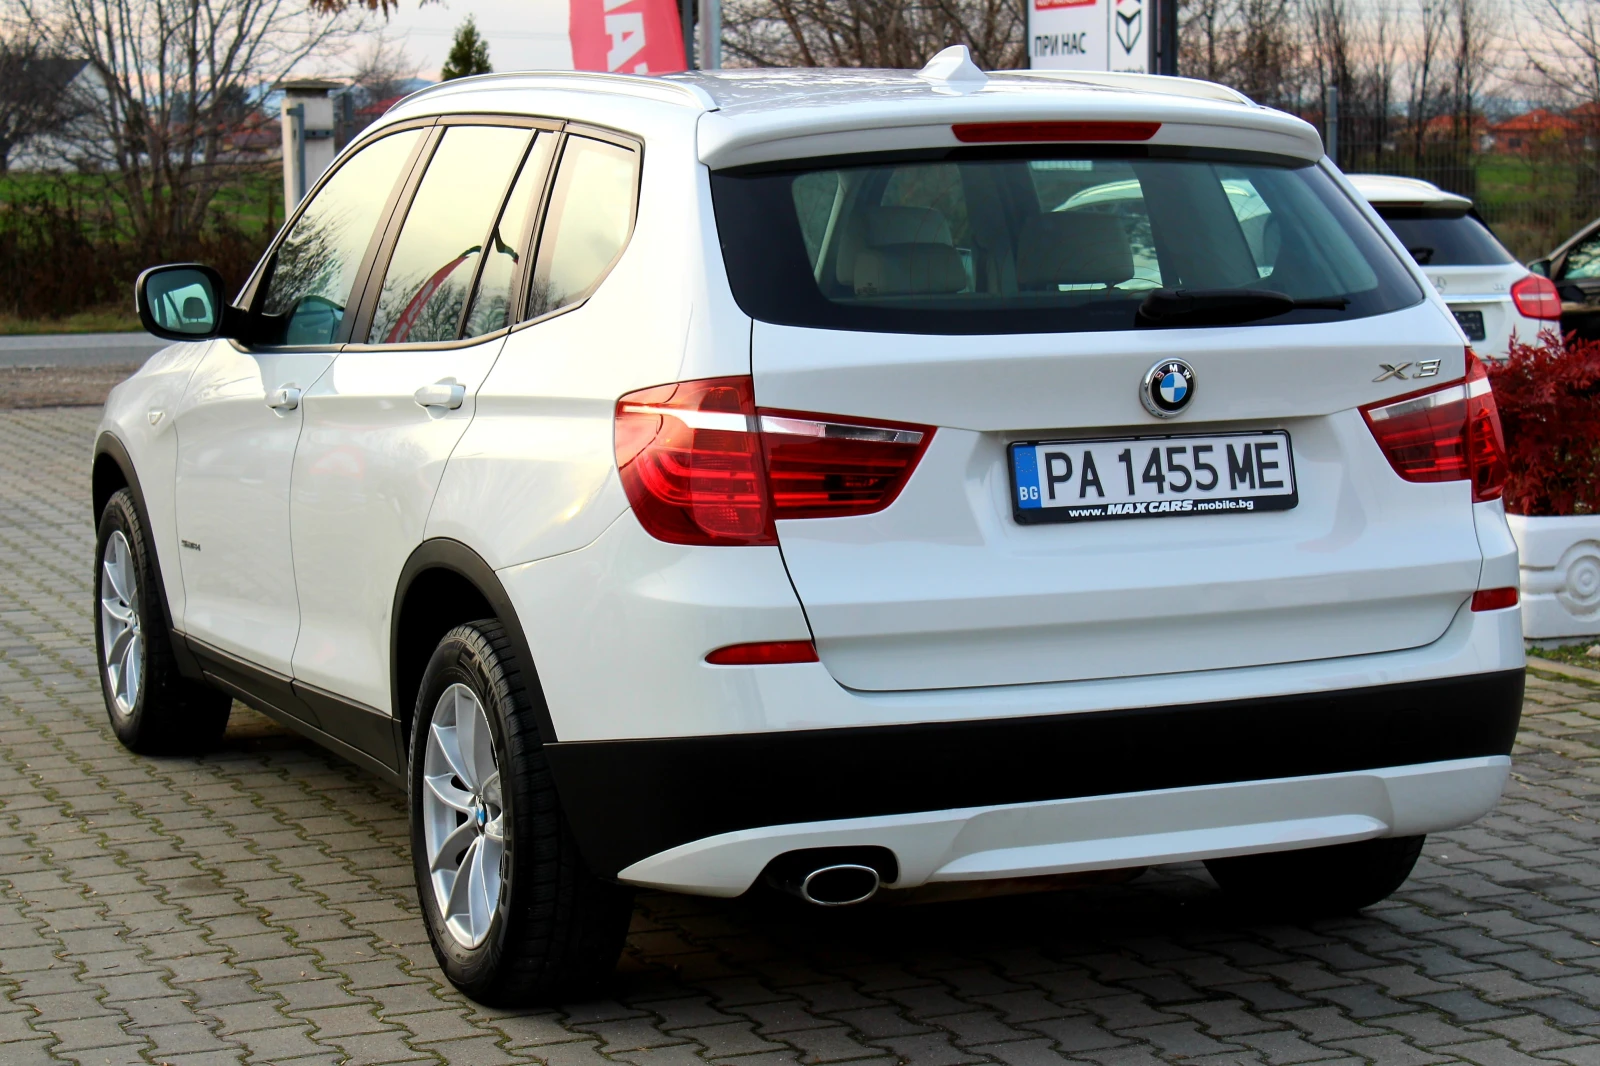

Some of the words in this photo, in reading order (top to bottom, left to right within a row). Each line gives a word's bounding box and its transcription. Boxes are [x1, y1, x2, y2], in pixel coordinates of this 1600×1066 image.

[1034, 35, 1059, 57] ПРИ
[1061, 32, 1087, 55] НАС
[1155, 363, 1192, 380] BMW
[1372, 358, 1442, 382] X3
[1045, 450, 1105, 500] PA
[1118, 444, 1219, 496] 1455
[1226, 442, 1284, 491] ME
[1019, 485, 1039, 501] BG
